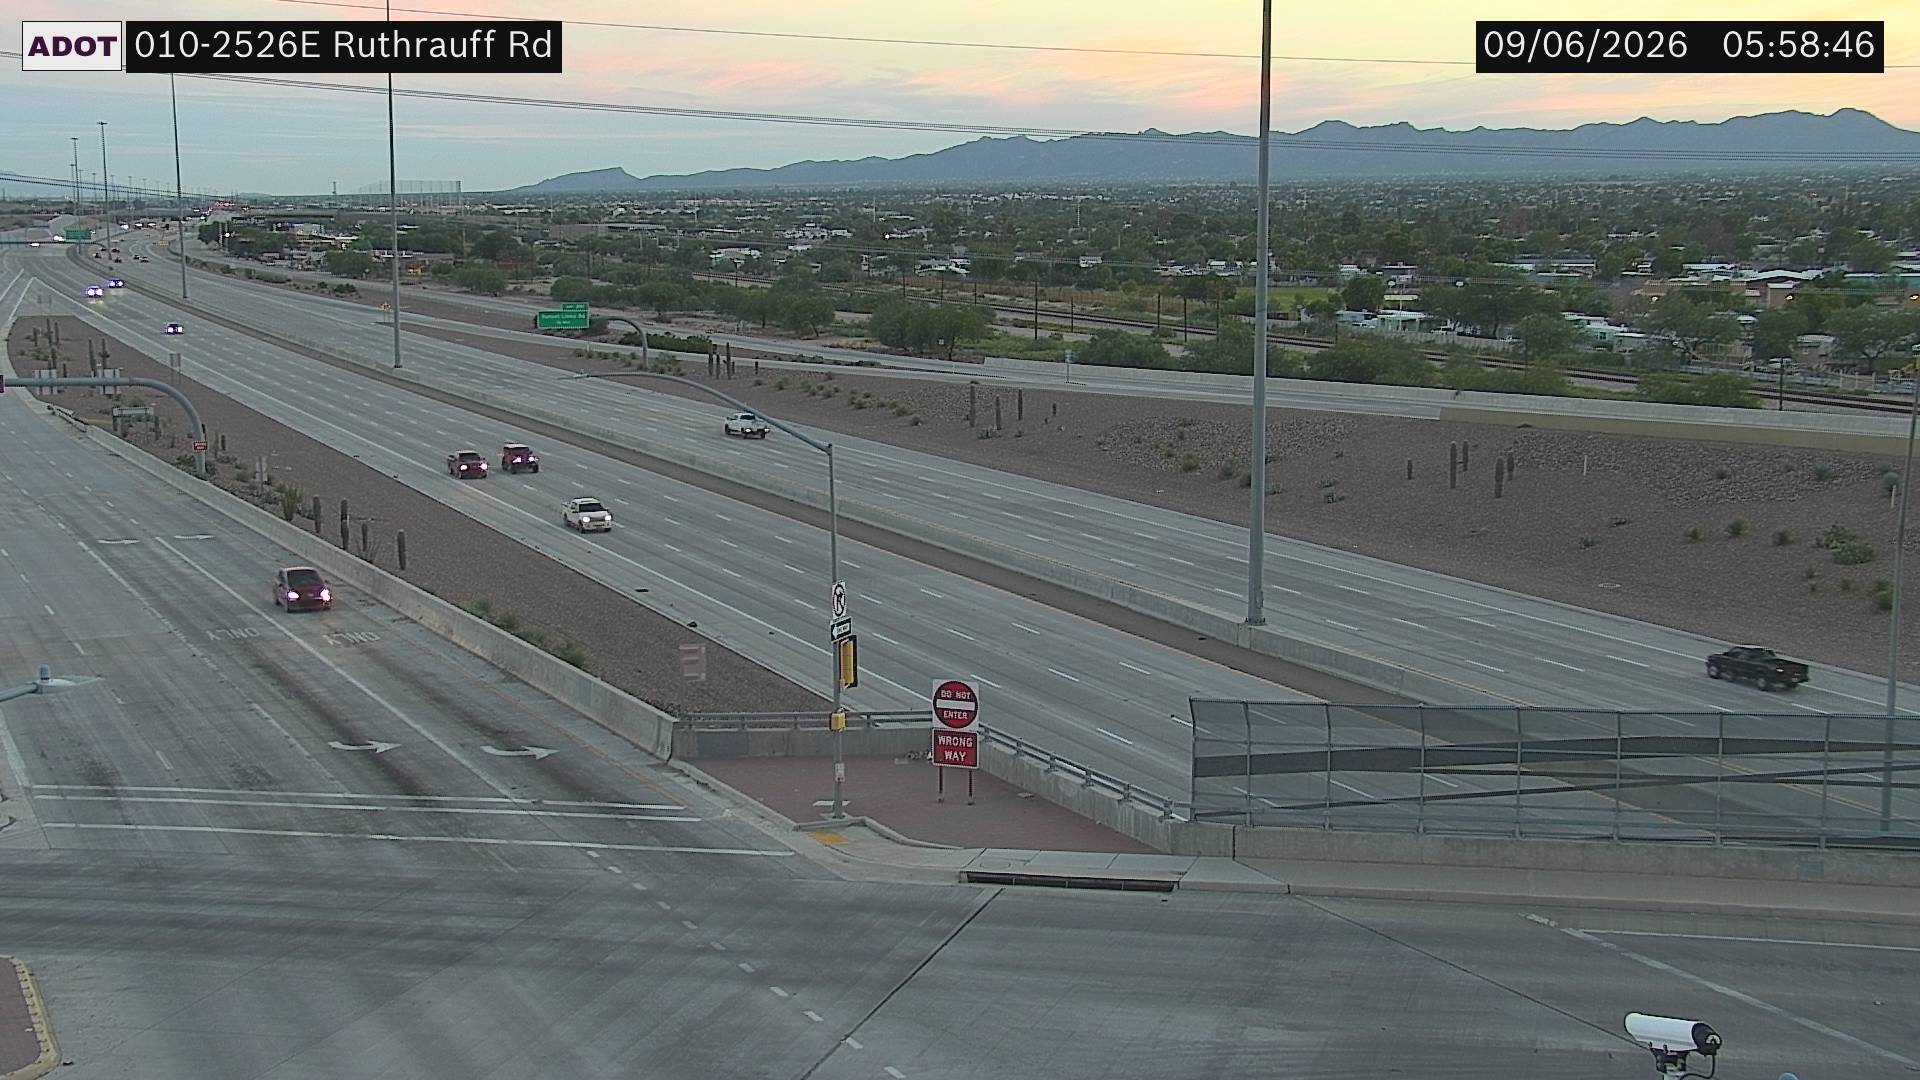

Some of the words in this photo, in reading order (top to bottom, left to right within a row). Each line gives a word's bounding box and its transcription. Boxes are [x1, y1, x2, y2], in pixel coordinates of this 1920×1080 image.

[941, 689, 952, 698] DO
[956, 691, 971, 700] NOT
[943, 710, 968, 720] ENTER
[938, 735, 973, 748] WRONG
[944, 750, 966, 762] WAY
